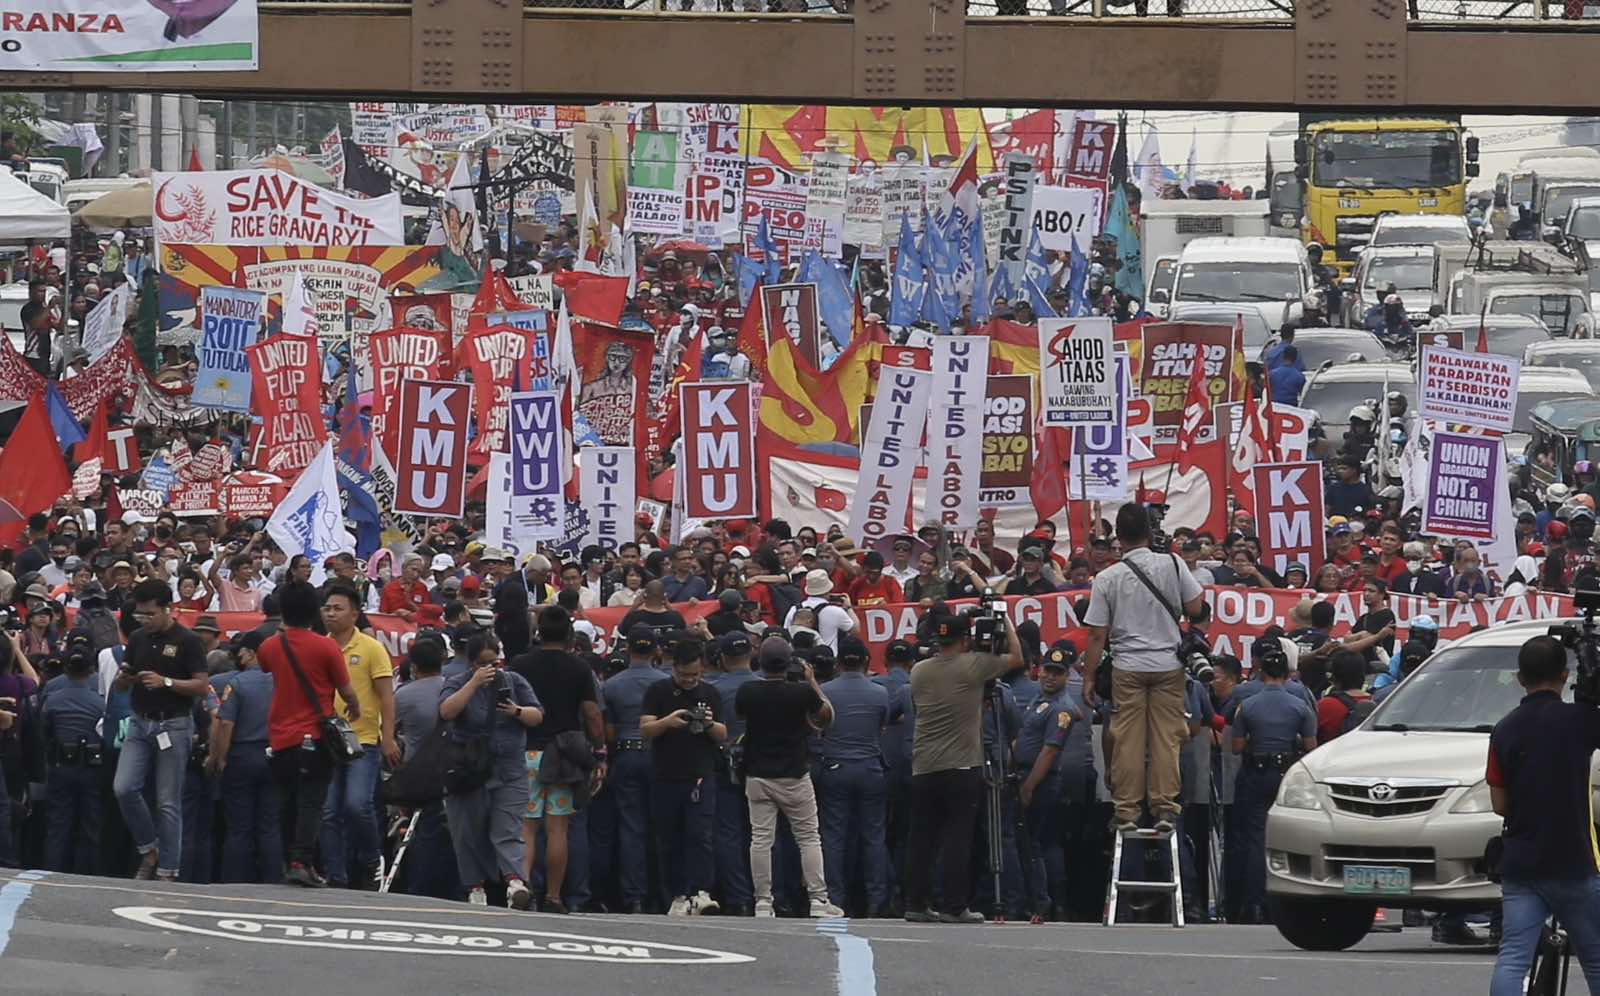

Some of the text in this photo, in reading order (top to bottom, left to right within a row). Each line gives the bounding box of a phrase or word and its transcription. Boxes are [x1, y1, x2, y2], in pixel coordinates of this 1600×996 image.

[2, 12, 125, 33] RANZA
[2, 39, 22, 52] O
[227, 174, 322, 220] SAVE
[1001, 161, 1031, 260] PSLINK
[231, 215, 369, 247] RICE GRANARY!
[344, 269, 366, 280] PARA
[528, 279, 542, 290] NA
[347, 281, 374, 296] LUPA!
[205, 296, 259, 321] MANDATORY
[202, 348, 250, 373] TUTULAN
[256, 341, 309, 373] UNITED
[376, 334, 437, 366] UNITED
[1059, 362, 1105, 383] ITAAS
[1428, 354, 1508, 373] MALAWAK NA
[266, 369, 305, 400] PUP
[1428, 366, 1511, 387] KARAPATAN
[1048, 395, 1112, 407] NAKABUBUHAY!
[1063, 385, 1095, 396] GAWING
[1428, 379, 1509, 399] AT SERBISYO
[1438, 392, 1512, 411] KABABAIHAN!
[271, 412, 316, 445] ACAD
[878, 374, 916, 467] UNITED
[940, 341, 970, 525] UNITED LABOR
[107, 429, 134, 470] T
[411, 387, 456, 508] KMU
[514, 402, 554, 491] WWU
[697, 389, 739, 512] KMU
[1440, 443, 1490, 467] UNION
[1439, 463, 1488, 478] ORGANIZING
[117, 489, 163, 507] MARCOS
[1437, 476, 1479, 499] NOT a
[597, 453, 619, 551] UNITED
[1434, 498, 1488, 520] CRIME!
[216, 917, 651, 958] MOTORSIKLO
